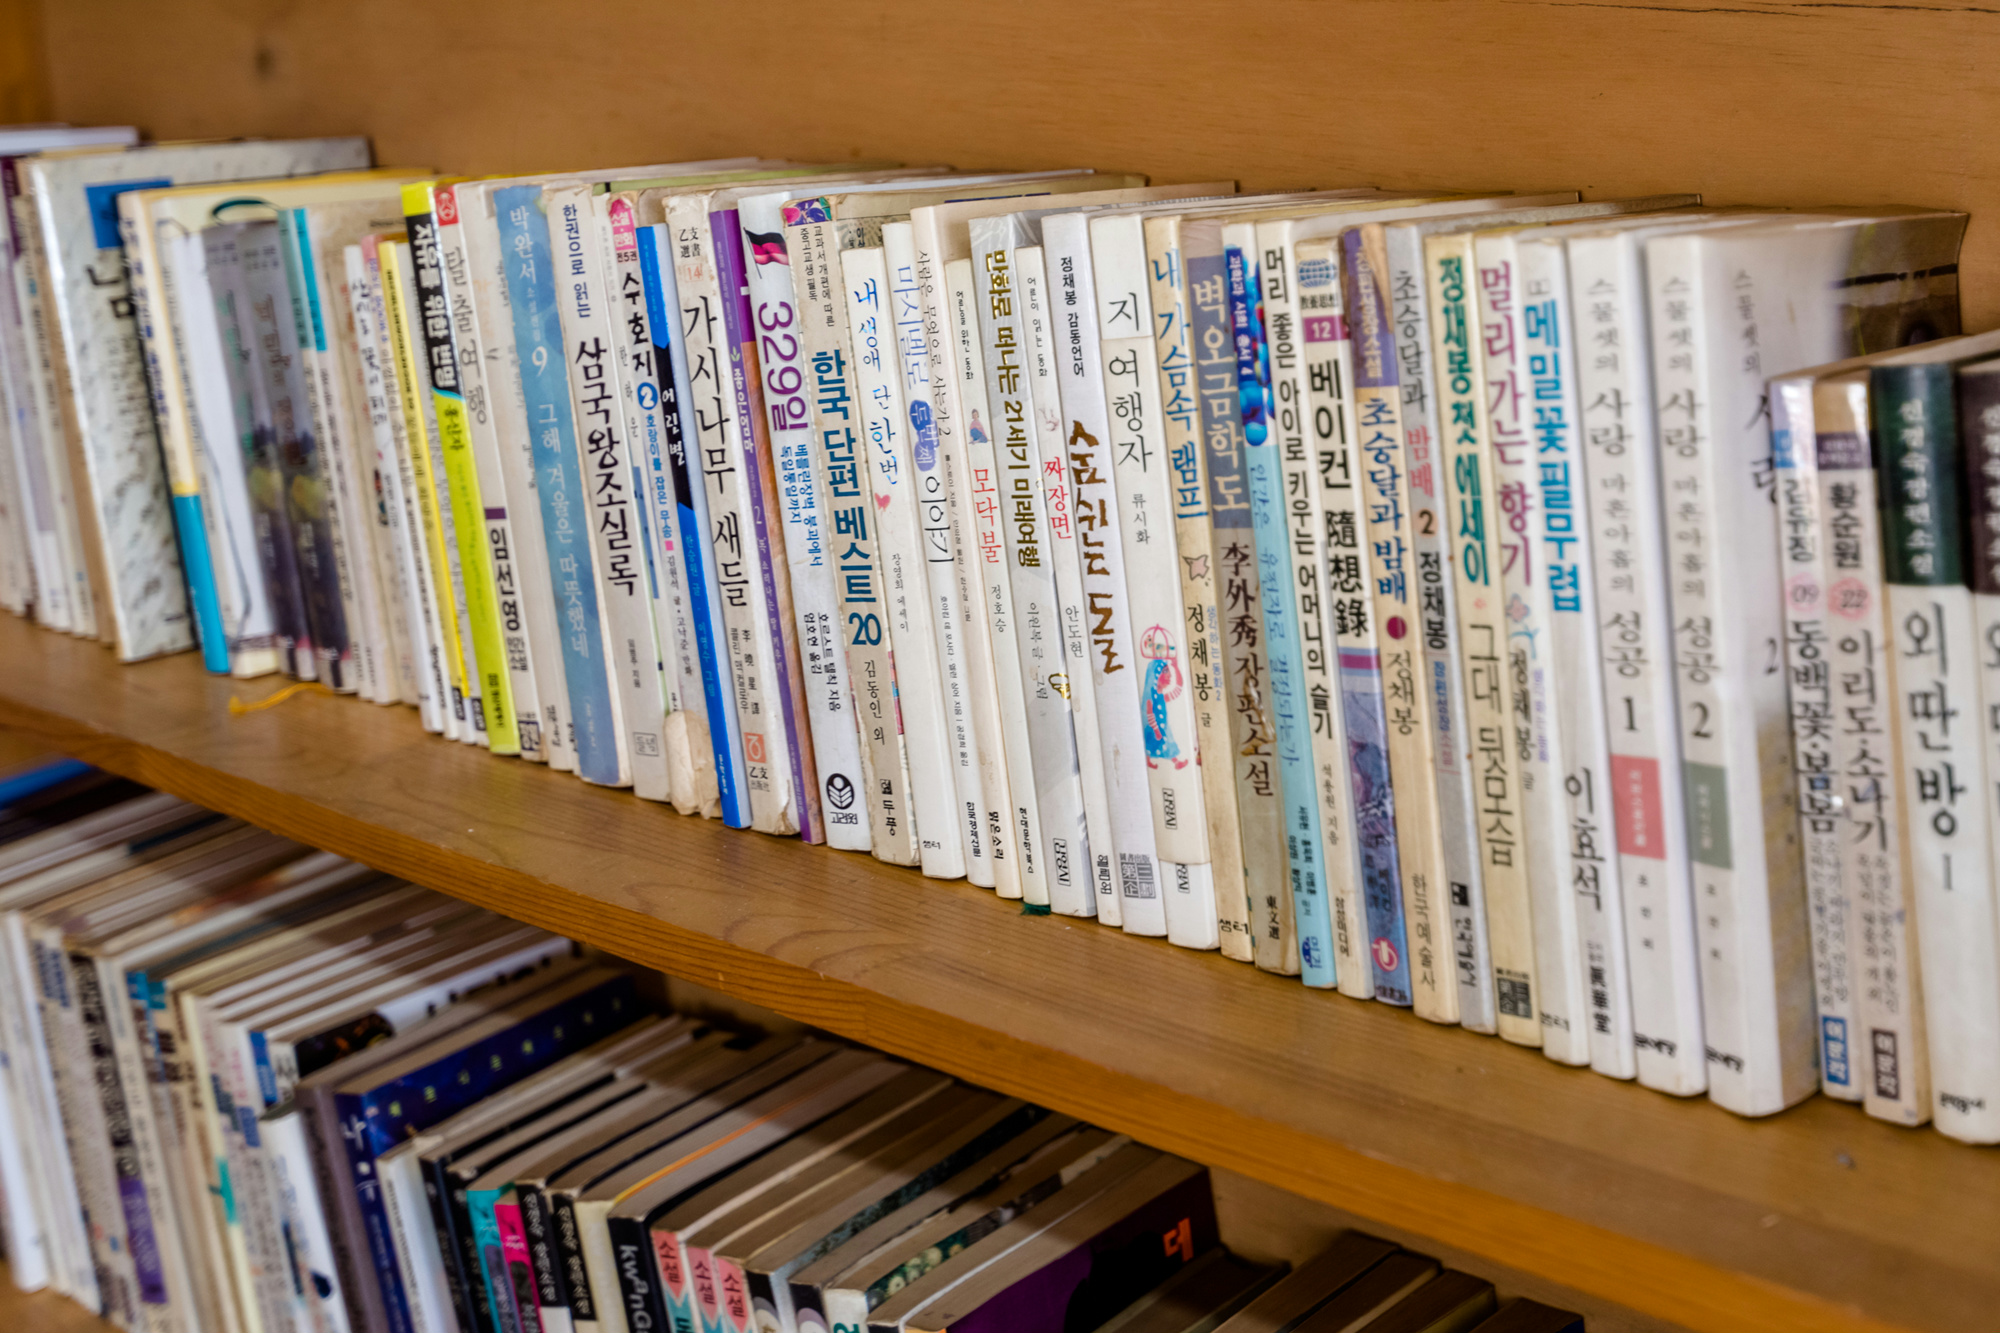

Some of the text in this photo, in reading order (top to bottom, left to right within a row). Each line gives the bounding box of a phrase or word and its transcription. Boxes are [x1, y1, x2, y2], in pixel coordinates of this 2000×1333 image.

[510, 205, 536, 284] 박완서
[562, 203, 591, 319] 한권으로 읽는
[686, 264, 703, 281] 14
[917, 249, 934, 298] 사람은
[1265, 246, 1290, 304] 머리
[413, 222, 457, 388] 자유를 위한 변명
[622, 271, 653, 377] 수호지
[639, 385, 656, 408] 2
[853, 277, 879, 313] 내
[872, 384, 892, 410] 단
[923, 304, 943, 368] 무엇으로
[1060, 255, 1085, 379] 정채봉 감동언어
[1233, 301, 1249, 329] 사회
[1271, 311, 1297, 370] 좋은
[1311, 321, 1332, 339] 12
[1437, 255, 1473, 396] 정채봉
[531, 345, 548, 377] 9
[757, 300, 809, 432] 329일
[1152, 247, 1210, 520] 내 가슴속 램프
[1191, 273, 1251, 512] 벽오금학도
[1393, 269, 1428, 414] 초승달과
[1418, 509, 1436, 536] 2
[683, 295, 736, 495] 가시나무
[712, 510, 750, 607] 새들
[985, 249, 1042, 568] 만화로 떠나는 21세기 미래여행
[1108, 348, 1153, 473] 여행자
[1279, 376, 1307, 462] 아이로
[1308, 358, 1352, 490] 베이컨
[1585, 387, 1635, 458] 사랑
[1659, 387, 1708, 459] 사랑
[546, 463, 574, 544] 겨울은
[575, 336, 638, 597] 삼국왕조실록
[780, 445, 802, 524] 독일통일까지
[794, 443, 824, 567] 베를린장벽 붕괴에서
[810, 348, 882, 646] 한국 단편 베스트 20
[1043, 455, 1072, 540] 짜장면
[1361, 397, 1408, 604] 초승달과 밤배
[659, 510, 673, 539] 무송
[920, 475, 955, 563] 이야기
[972, 467, 1002, 564] 모닥불
[1131, 493, 1151, 545] 류시화
[1288, 469, 1316, 557] 키우는
[1454, 452, 1491, 588] 에세이
[1496, 479, 1534, 588] 향기
[490, 527, 521, 631] 임선영
[559, 553, 589, 659] 따뜻했네
[990, 583, 1007, 634] 정호승
[1220, 541, 1258, 649] 李外秀
[1298, 563, 1327, 676] 어머니의
[1419, 550, 1448, 651] 정채봉
[809, 651, 823, 675] 옮김
[817, 612, 834, 658] 호르스트
[828, 688, 842, 713] 지음
[1064, 604, 1084, 659] 안도현
[1087, 592, 1125, 675] 돌
[1187, 602, 1213, 728] 정채봉 글
[1601, 609, 1650, 680] 성공
[1676, 614, 1723, 686] 성공
[863, 659, 886, 746] 김동인 외
[954, 700, 963, 716] 지음
[960, 750, 970, 767] 옮김
[1309, 682, 1333, 740] 슬기
[1386, 648, 1420, 736] 정채봉
[1623, 695, 1638, 732] 1
[1690, 700, 1714, 740] 2
[1903, 600, 1968, 838] 외딴방
[1469, 622, 1517, 868] 그대 뒷모습
[988, 810, 1004, 861] 맑은소리
[1564, 766, 1606, 913] 이효석
[1218, 917, 1250, 935] 샘터
[657, 1239, 682, 1284] 소설
[694, 1259, 716, 1306] 소설
[723, 1272, 746, 1319] 소설
